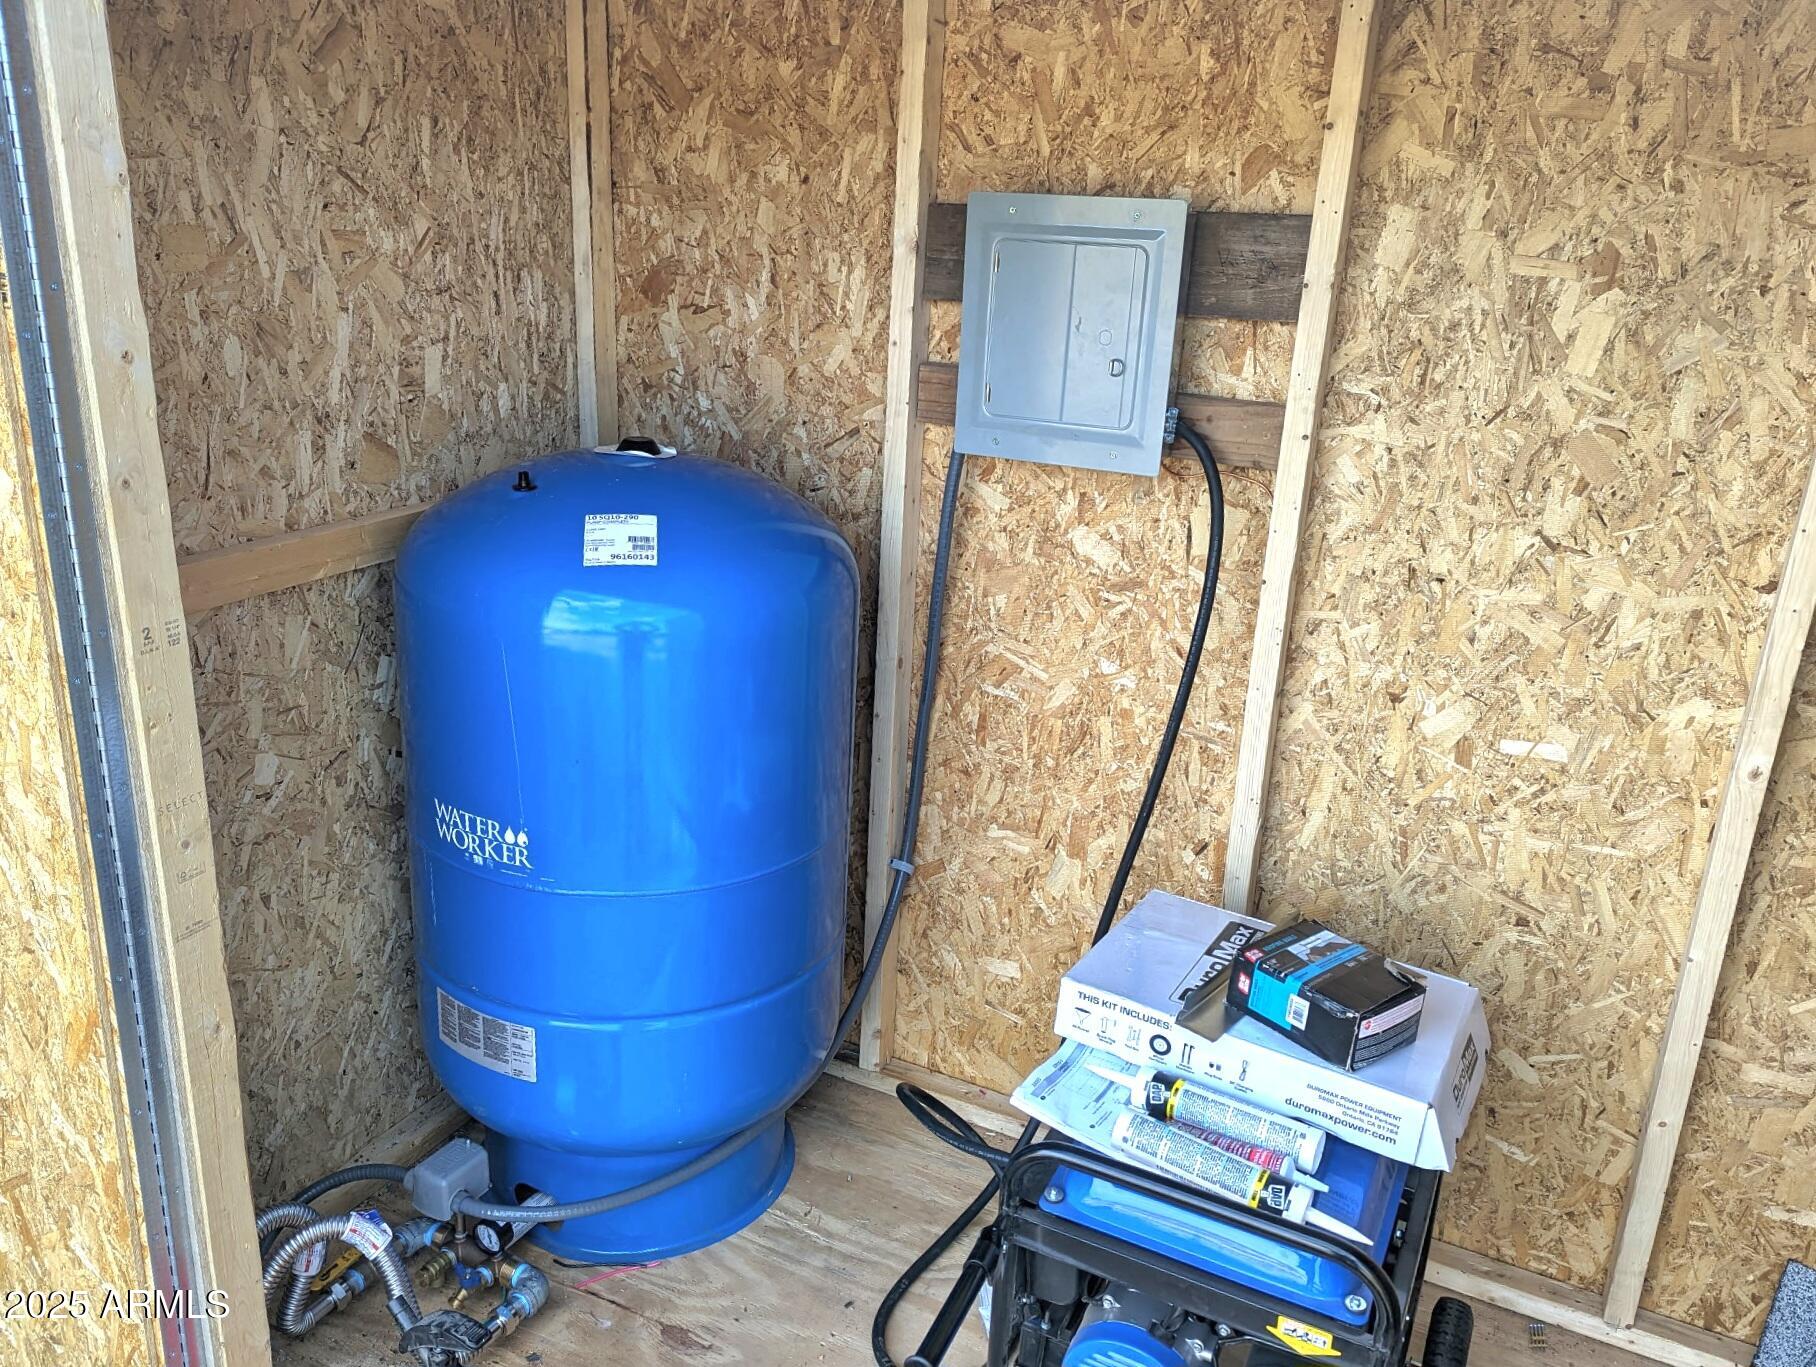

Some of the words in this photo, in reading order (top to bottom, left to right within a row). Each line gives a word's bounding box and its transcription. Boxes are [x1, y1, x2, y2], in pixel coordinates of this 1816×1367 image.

[142, 627, 152, 640] 2
[158, 791, 204, 816] SELECT
[434, 797, 505, 843] WATER
[435, 817, 534, 869] WORKER
[1078, 990, 1100, 1005] THIS
[1101, 999, 1118, 1011] KIT
[1119, 1006, 1172, 1031] INCLUDES:
[1284, 1097, 1397, 1145] duromaxpower.com
[1306, 1083, 1339, 1099] DUROMAX
[1340, 1095, 1363, 1108] POWER
[1364, 1103, 1402, 1122] EQUIPMENT
[1335, 1101, 1358, 1113] Ontario
[1366, 1120, 1376, 1128] CA
